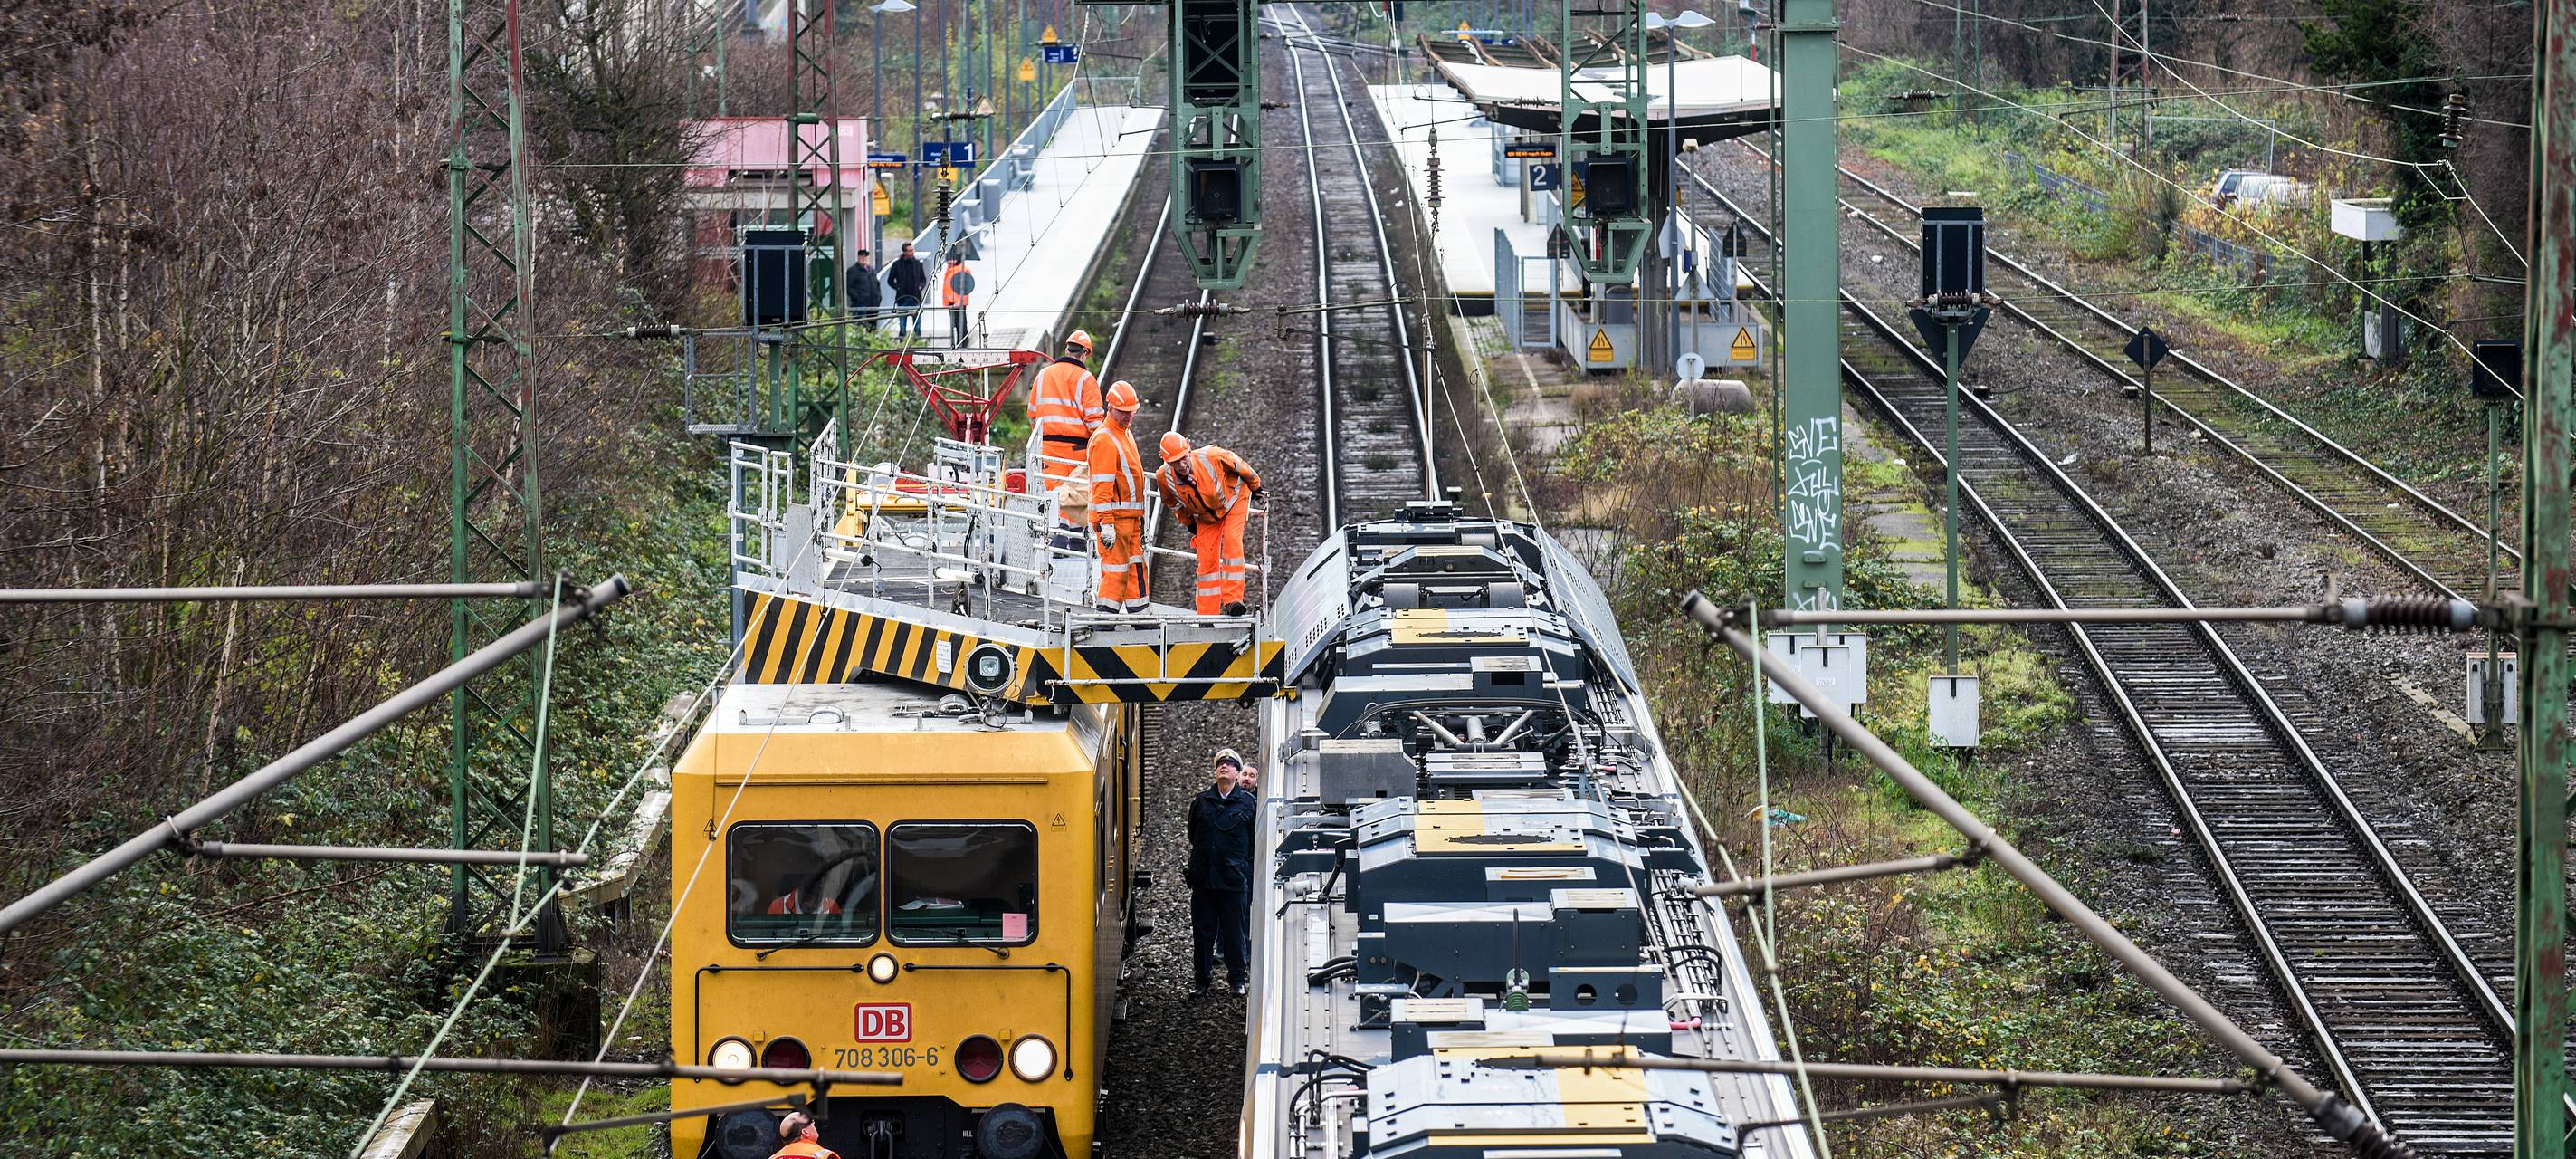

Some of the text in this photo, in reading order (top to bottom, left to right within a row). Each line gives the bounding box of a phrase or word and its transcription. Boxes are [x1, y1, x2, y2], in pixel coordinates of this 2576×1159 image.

[963, 143, 973, 162] 1
[1533, 165, 1547, 186] 2
[862, 1009, 906, 1037] DB
[835, 1046, 939, 1068] 708 306-6
